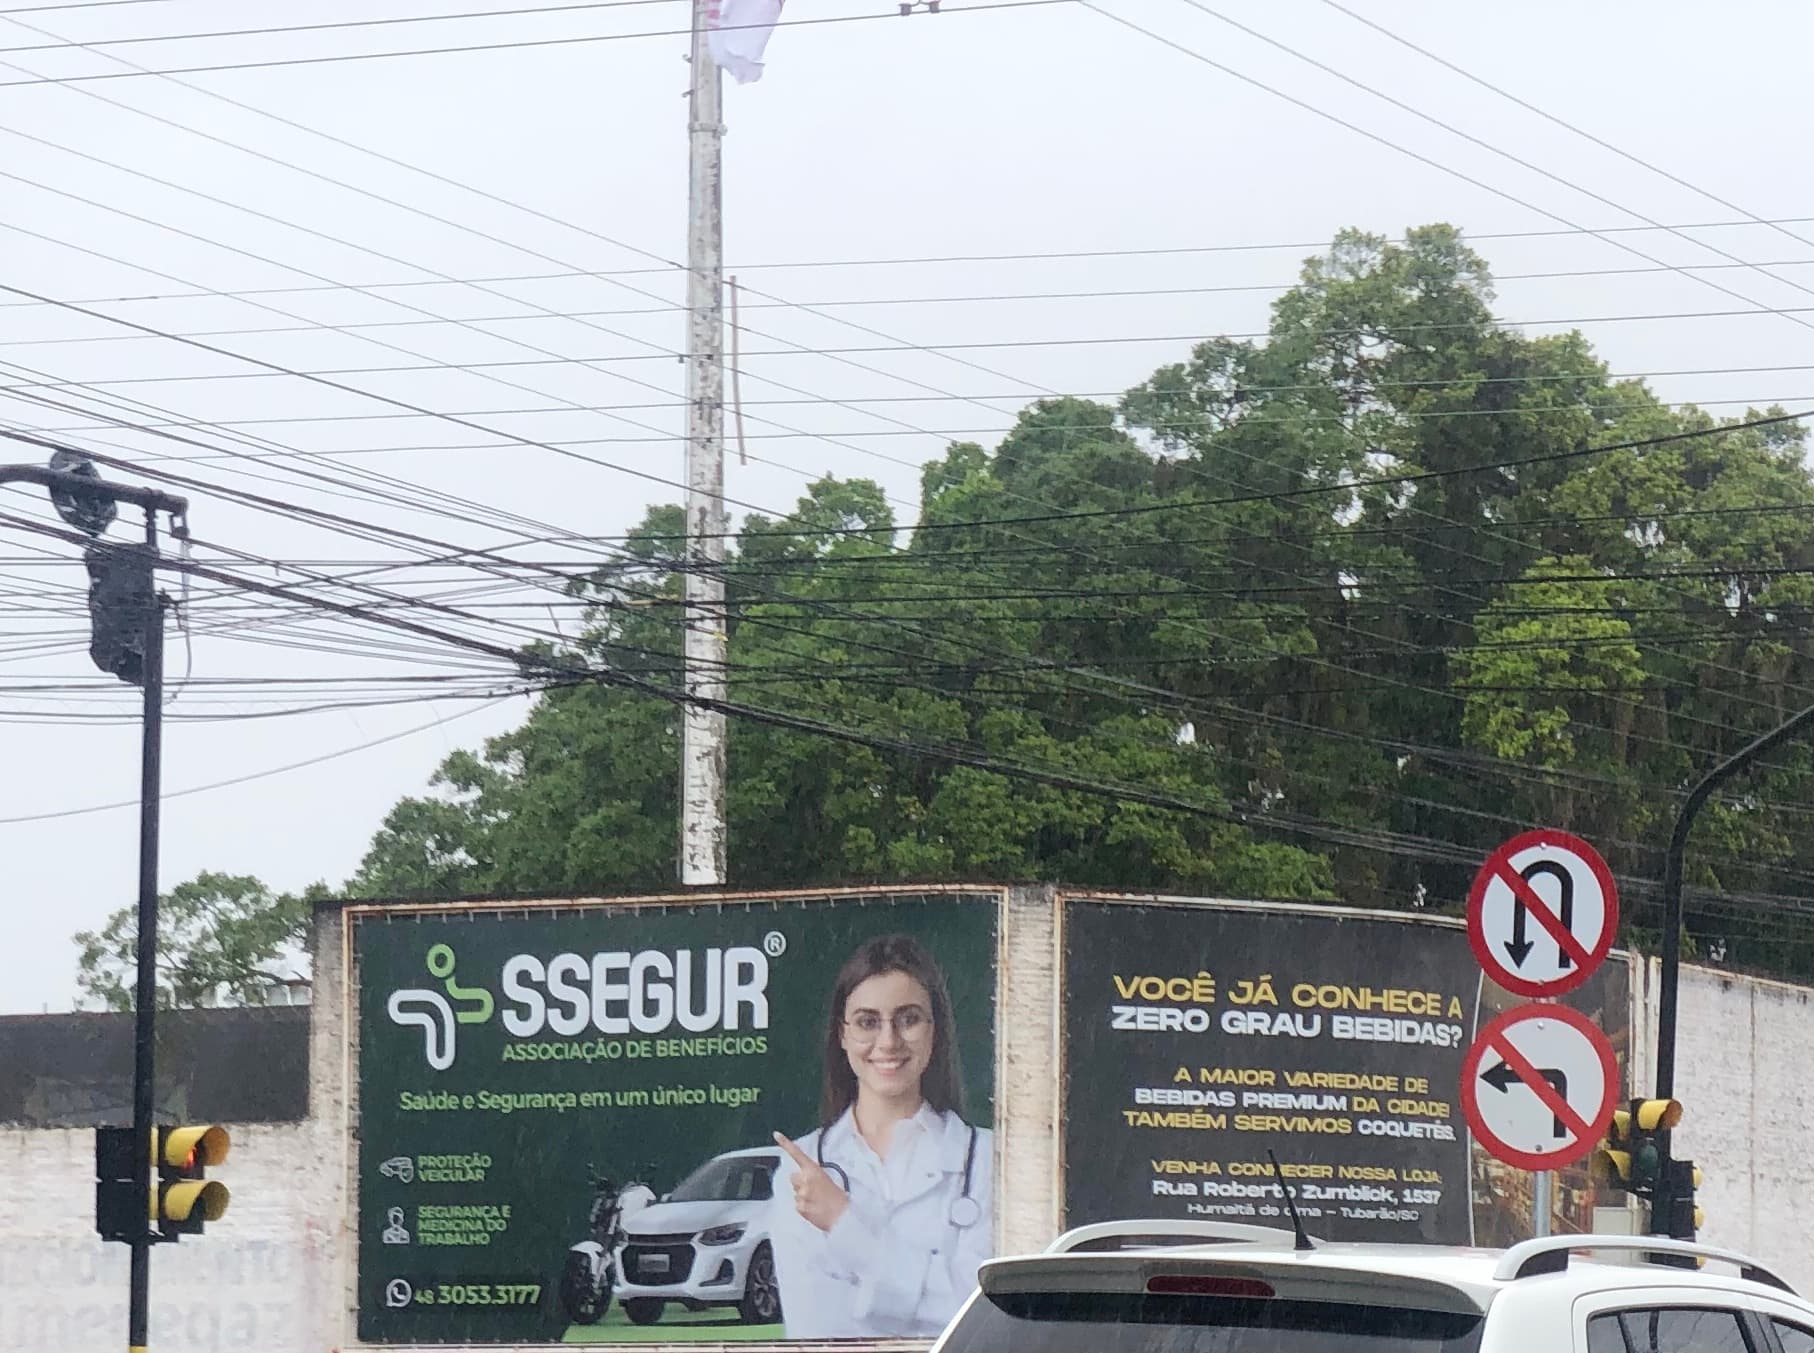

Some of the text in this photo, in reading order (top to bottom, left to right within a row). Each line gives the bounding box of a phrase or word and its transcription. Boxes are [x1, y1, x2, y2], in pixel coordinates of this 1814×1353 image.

[502, 947, 769, 1038] SSEGUR
[1113, 971, 1463, 1020] VOCÊ JÁ CONHECE A
[1111, 1005, 1463, 1049] ZERO GRAU BEBIDAS?
[503, 1034, 769, 1063] ASSOCIAÇÃO DE BENEFÍCIOS
[1173, 1067, 1429, 1094] A MAIOR VARIEDADE DE
[400, 1084, 761, 1114] Saúde e Segurança em um único lugar
[1135, 1087, 1236, 1108] BEBIDAS
[1242, 1091, 1348, 1112] PREMIUM
[1352, 1096, 1381, 1113] DA
[1123, 1109, 1227, 1130] TAMBÉM
[1233, 1113, 1352, 1135] SERVIMOS
[417, 1152, 492, 1168] PROTEÇÃO
[1151, 1159, 1223, 1176] VENHA
[1338, 1166, 1398, 1182] NOSSA
[417, 1169, 486, 1183] VEICULAR
[1152, 1180, 1199, 1197] Rua
[1203, 1180, 1297, 1199] Roberto
[417, 1205, 512, 1219] SEGURANÇA E
[1258, 1203, 1287, 1217] de
[486, 1218, 508, 1232] DO
[417, 1232, 491, 1246] TRABALHO
